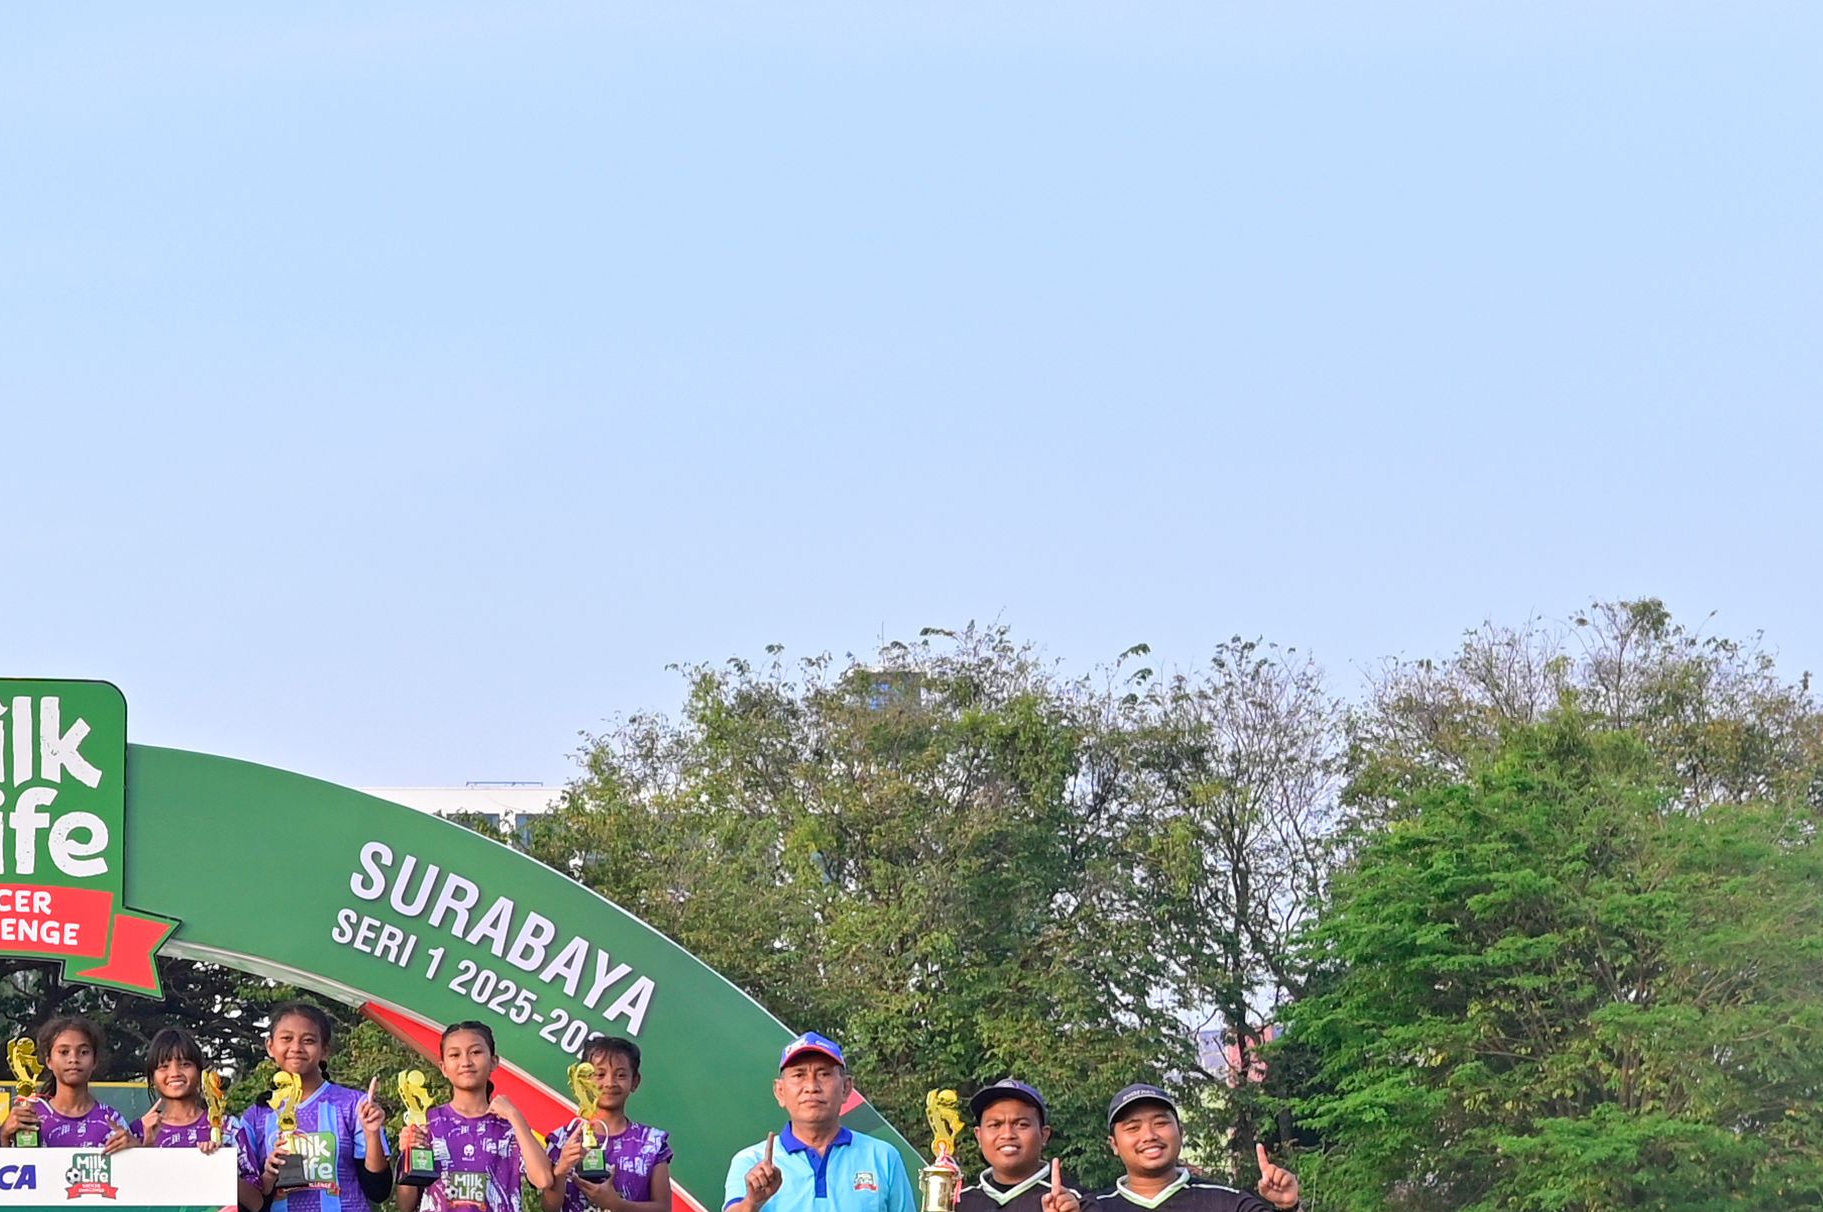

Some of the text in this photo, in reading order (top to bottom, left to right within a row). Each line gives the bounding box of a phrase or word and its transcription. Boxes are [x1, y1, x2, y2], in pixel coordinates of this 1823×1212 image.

[349, 841, 657, 1037] SURABAYA
[331, 908, 604, 1060] SERI 1 2025-20
[77, 1155, 107, 1170] Milk
[303, 1157, 333, 1180] ife
[81, 1168, 109, 1183] Life
[454, 1173, 484, 1189] Milk
[458, 1186, 484, 1202] Life
